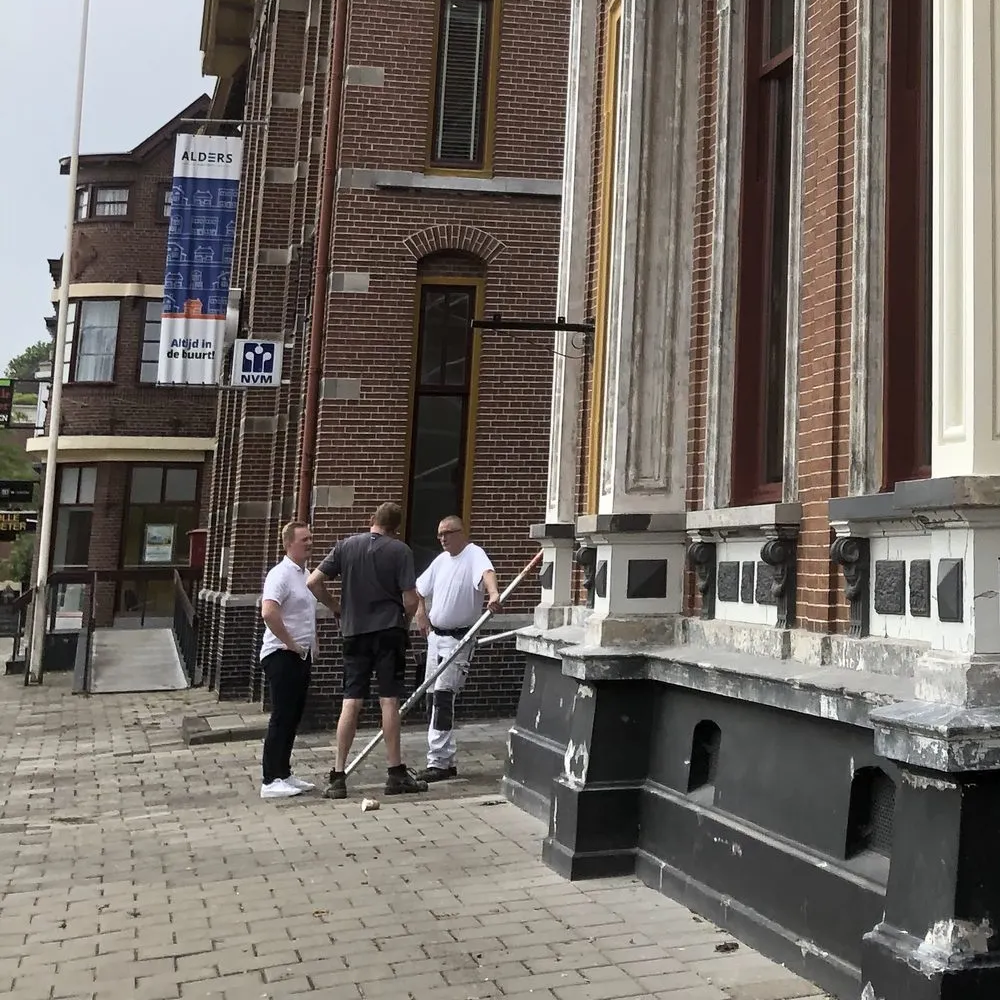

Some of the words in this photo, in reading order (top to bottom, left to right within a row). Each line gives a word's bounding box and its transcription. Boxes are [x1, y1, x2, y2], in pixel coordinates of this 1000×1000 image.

[181, 150, 233, 164] ALDERS
[171, 338, 199, 350] Altijd
[201, 338, 212, 349] in
[166, 349, 180, 359] de
[181, 350, 215, 360] buurt!
[240, 374, 273, 384] NVM
